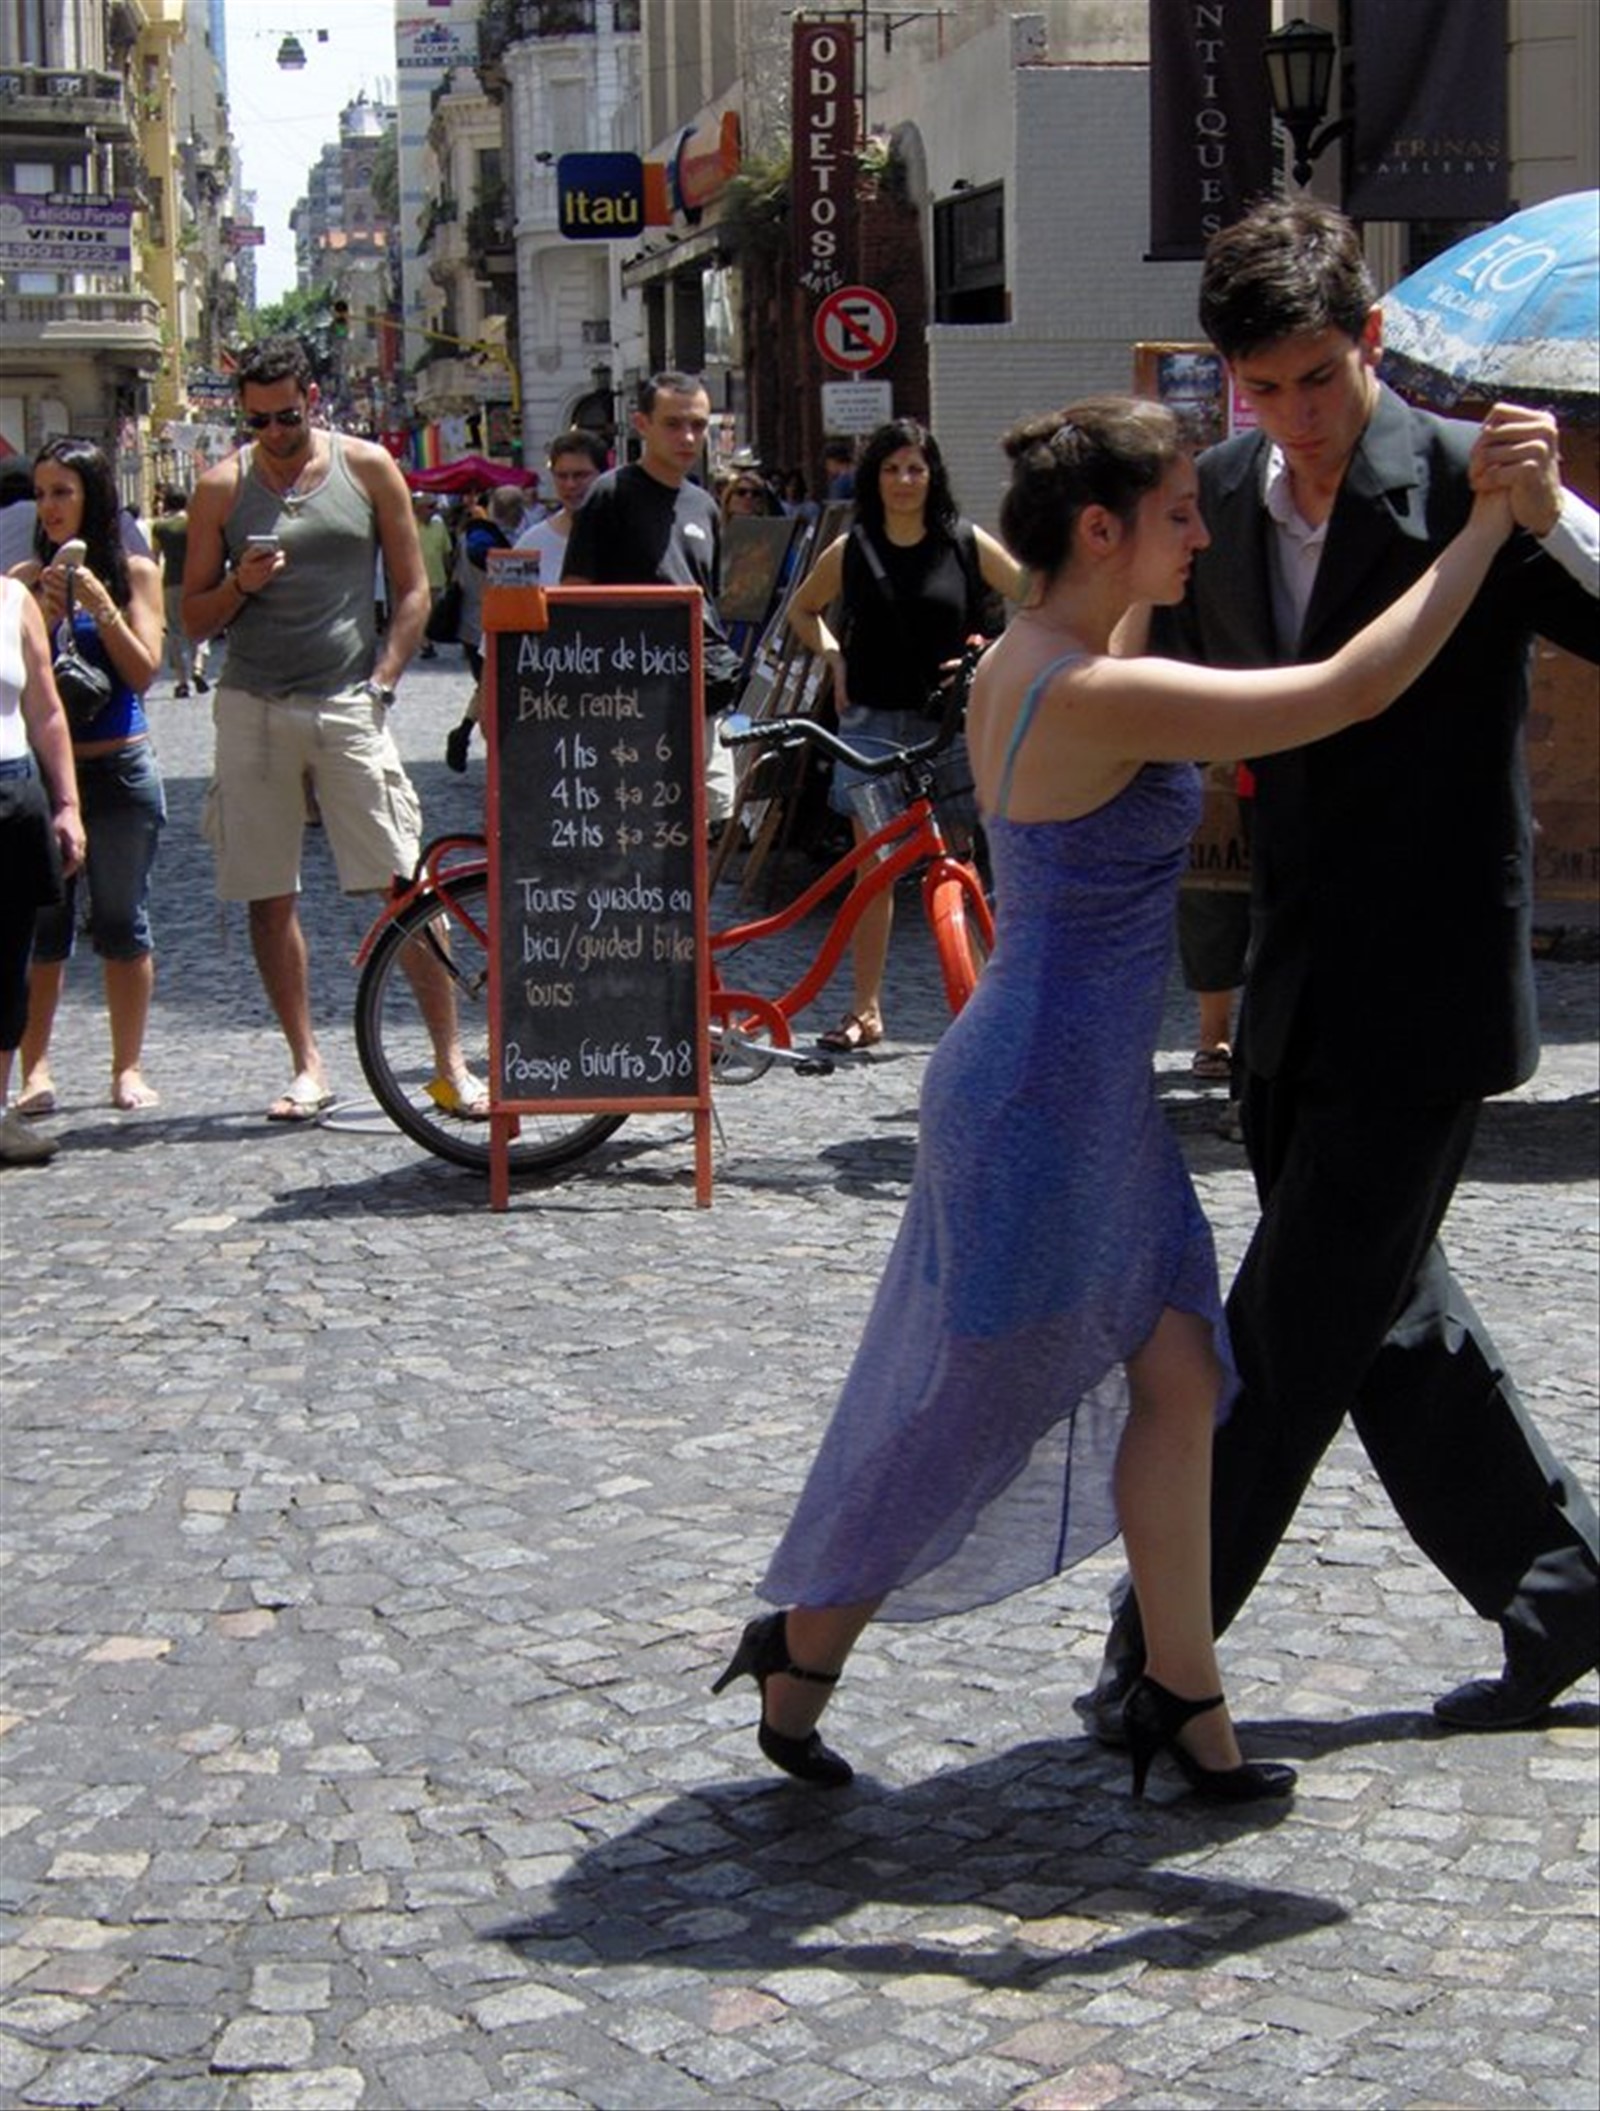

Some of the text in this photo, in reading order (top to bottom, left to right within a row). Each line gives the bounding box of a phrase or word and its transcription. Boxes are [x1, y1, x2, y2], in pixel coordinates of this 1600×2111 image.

[564, 190, 639, 226] Itaú
[27, 228, 108, 242] VENDE
[611, 637, 637, 670] de
[641, 631, 690, 675] bicis
[517, 686, 645, 720] Bike rental
[655, 733, 672, 762] 6
[652, 781, 681, 808] 20
[652, 821, 689, 849] 36
[515, 871, 692, 931] Tours guiados en
[653, 925, 694, 961] bike
[505, 1042, 571, 1091] Pasaje
